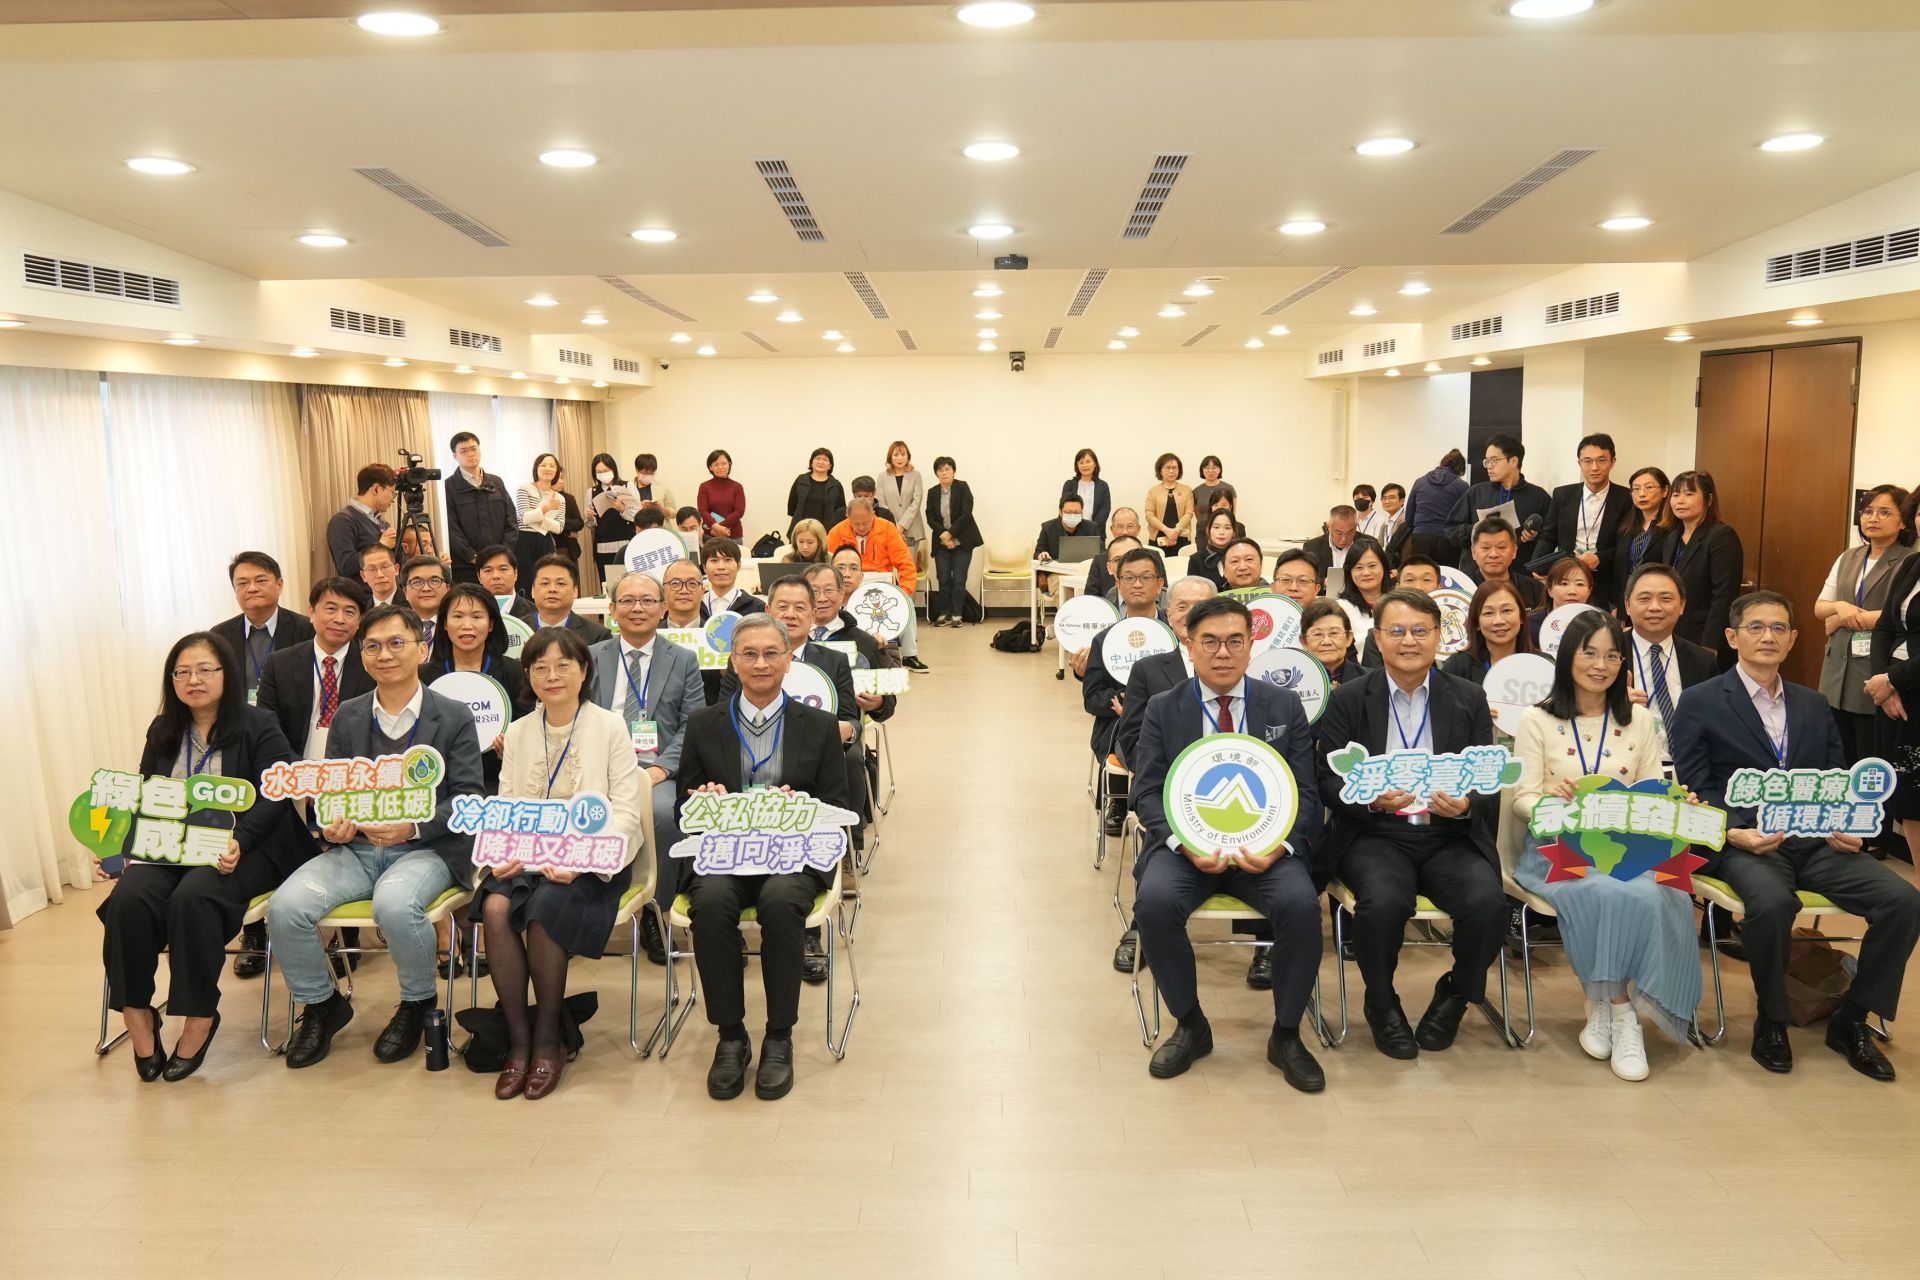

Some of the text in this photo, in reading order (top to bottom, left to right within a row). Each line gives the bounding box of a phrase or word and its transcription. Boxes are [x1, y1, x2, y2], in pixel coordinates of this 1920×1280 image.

[632, 546, 678, 573] SPIL
[1502, 678, 1553, 705] SGS
[265, 758, 404, 796] 水資源永續
[1211, 752, 1260, 768] 環境部
[1345, 750, 1506, 801] 淨零臺灣
[90, 769, 188, 820] 綠色
[193, 782, 247, 807] GO!
[319, 787, 432, 824] 循環低碳
[1731, 772, 1850, 805] 綠色醫療
[456, 799, 568, 834] 冷卻行動
[684, 793, 818, 832] 公私協力
[1183, 793, 1277, 845] Ministry of Environment
[1534, 792, 1726, 850] 永續發展
[1762, 803, 1880, 835] 循環減量
[133, 820, 233, 866] 成長
[477, 831, 623, 869] 降溫又減碳
[701, 829, 845, 872] 邁向淨零
